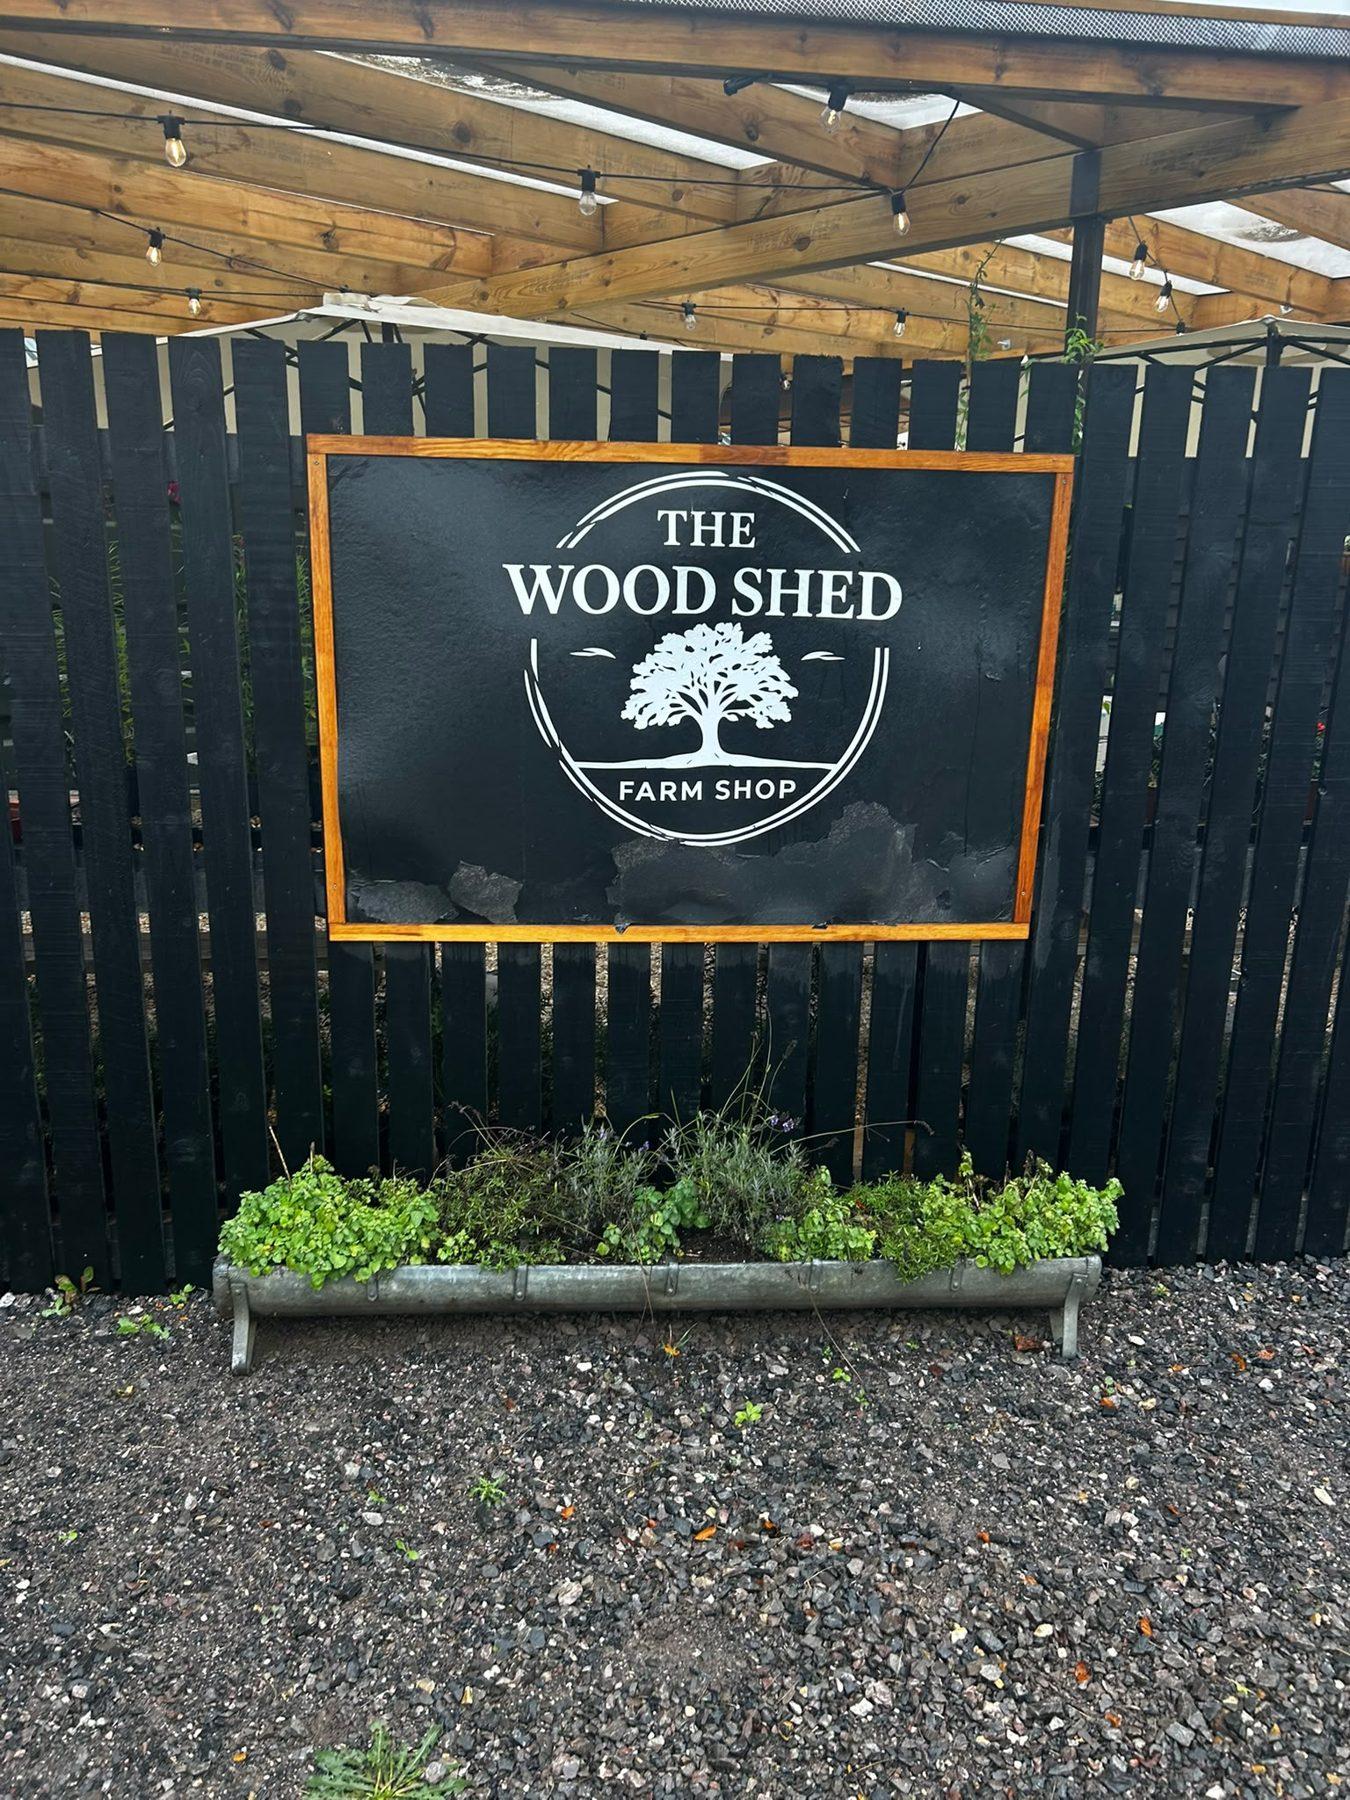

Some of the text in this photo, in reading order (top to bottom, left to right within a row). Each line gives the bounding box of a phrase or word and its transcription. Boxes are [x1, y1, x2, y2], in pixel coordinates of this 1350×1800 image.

[657, 509, 756, 549] THE
[501, 563, 903, 621] WOOD SHED
[618, 778, 797, 802] FARM SHOP
